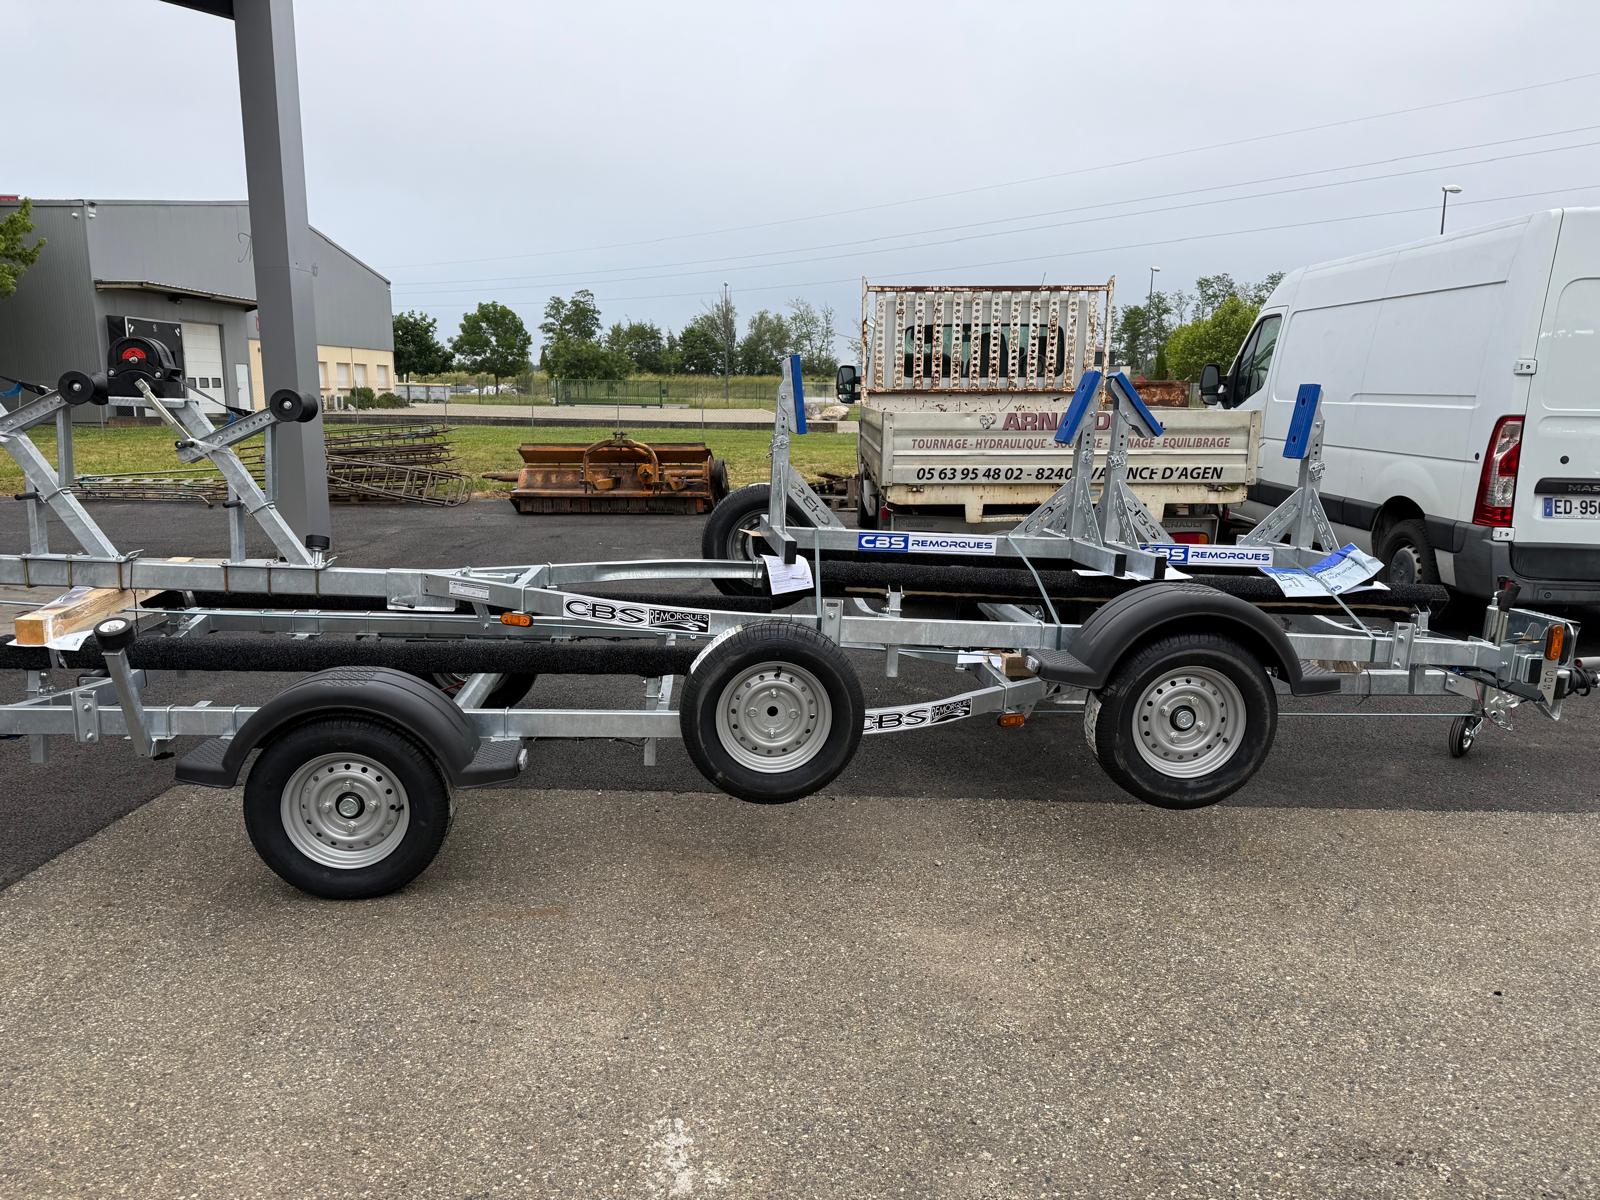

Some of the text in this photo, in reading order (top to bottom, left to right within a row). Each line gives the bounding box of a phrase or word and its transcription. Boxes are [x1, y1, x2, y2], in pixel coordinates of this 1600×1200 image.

[912, 439, 967, 449] TOURNAGE
[975, 438, 1047, 450] HYDRAULIQUE
[1162, 437, 1231, 449] EQUILIBRAGE
[916, 467, 935, 480] 05
[938, 467, 957, 480] 63
[960, 467, 979, 480] 95
[982, 467, 1001, 480] 48
[1004, 467, 1023, 480] 02
[1035, 467, 1073, 480] 8240
[1554, 499, 1600, 515] ED-95
[861, 535, 993, 550] CBS REMORQUES
[1191, 551, 1270, 561] REMORQUES
[565, 600, 709, 625] CBS REMORQUES
